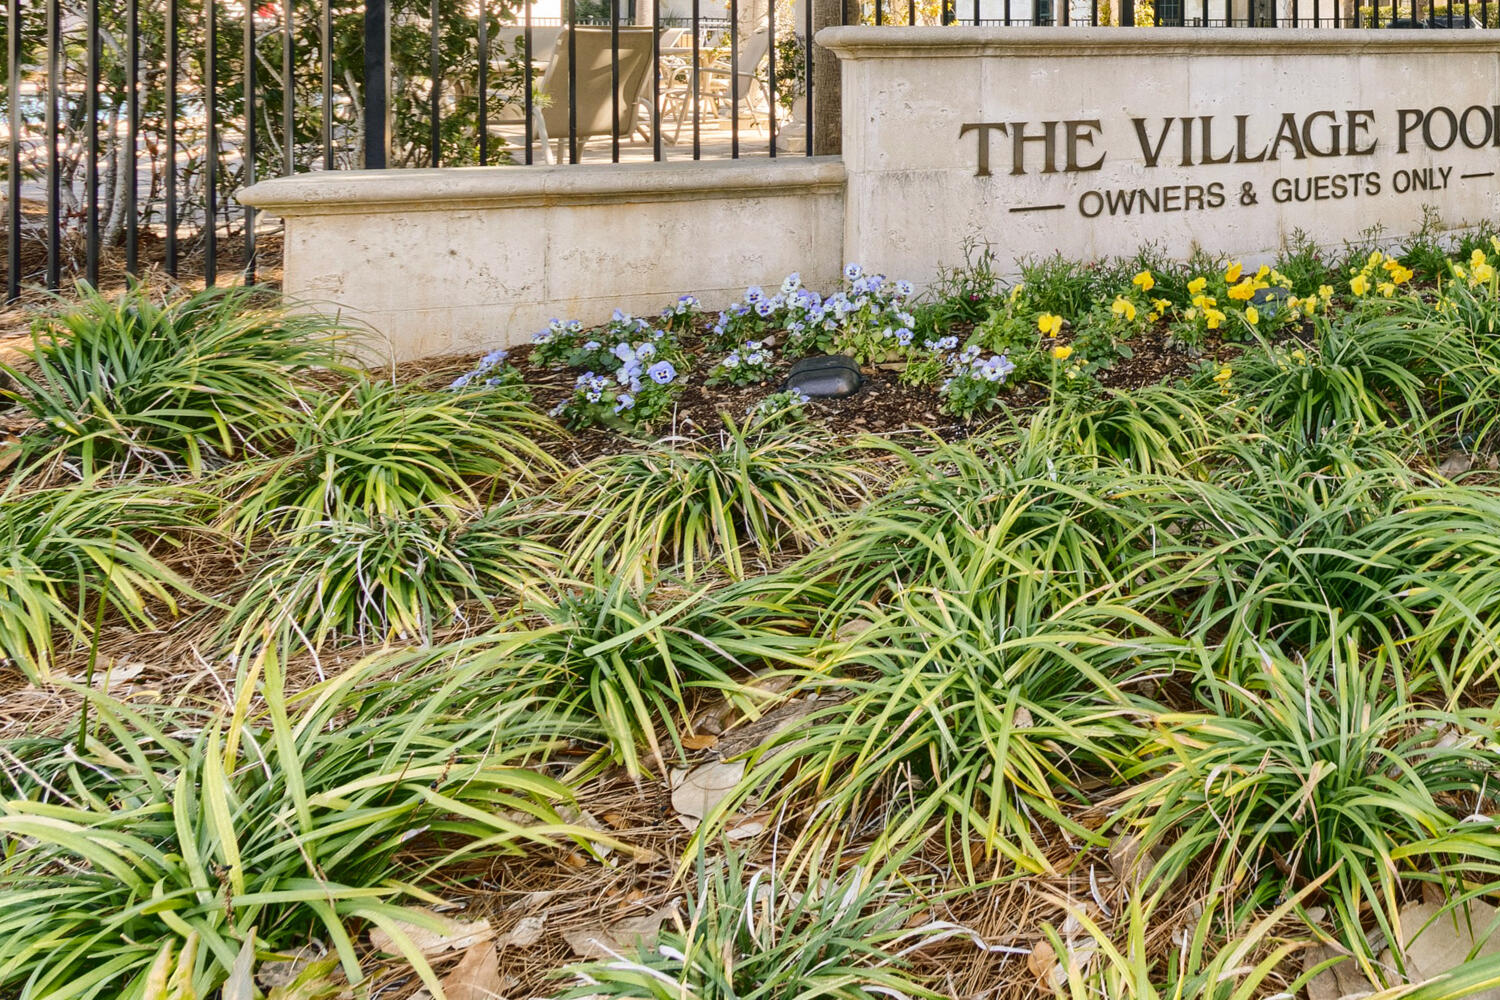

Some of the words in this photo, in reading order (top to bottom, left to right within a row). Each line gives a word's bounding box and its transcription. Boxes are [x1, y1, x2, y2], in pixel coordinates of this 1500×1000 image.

[959, 119, 1107, 177] THE
[1131, 109, 1379, 168] VILLAGE
[1079, 181, 1226, 218] OWNERS
[1240, 181, 1258, 206] &
[1272, 171, 1382, 204] GUESTS
[1392, 165, 1453, 194] ONLY
